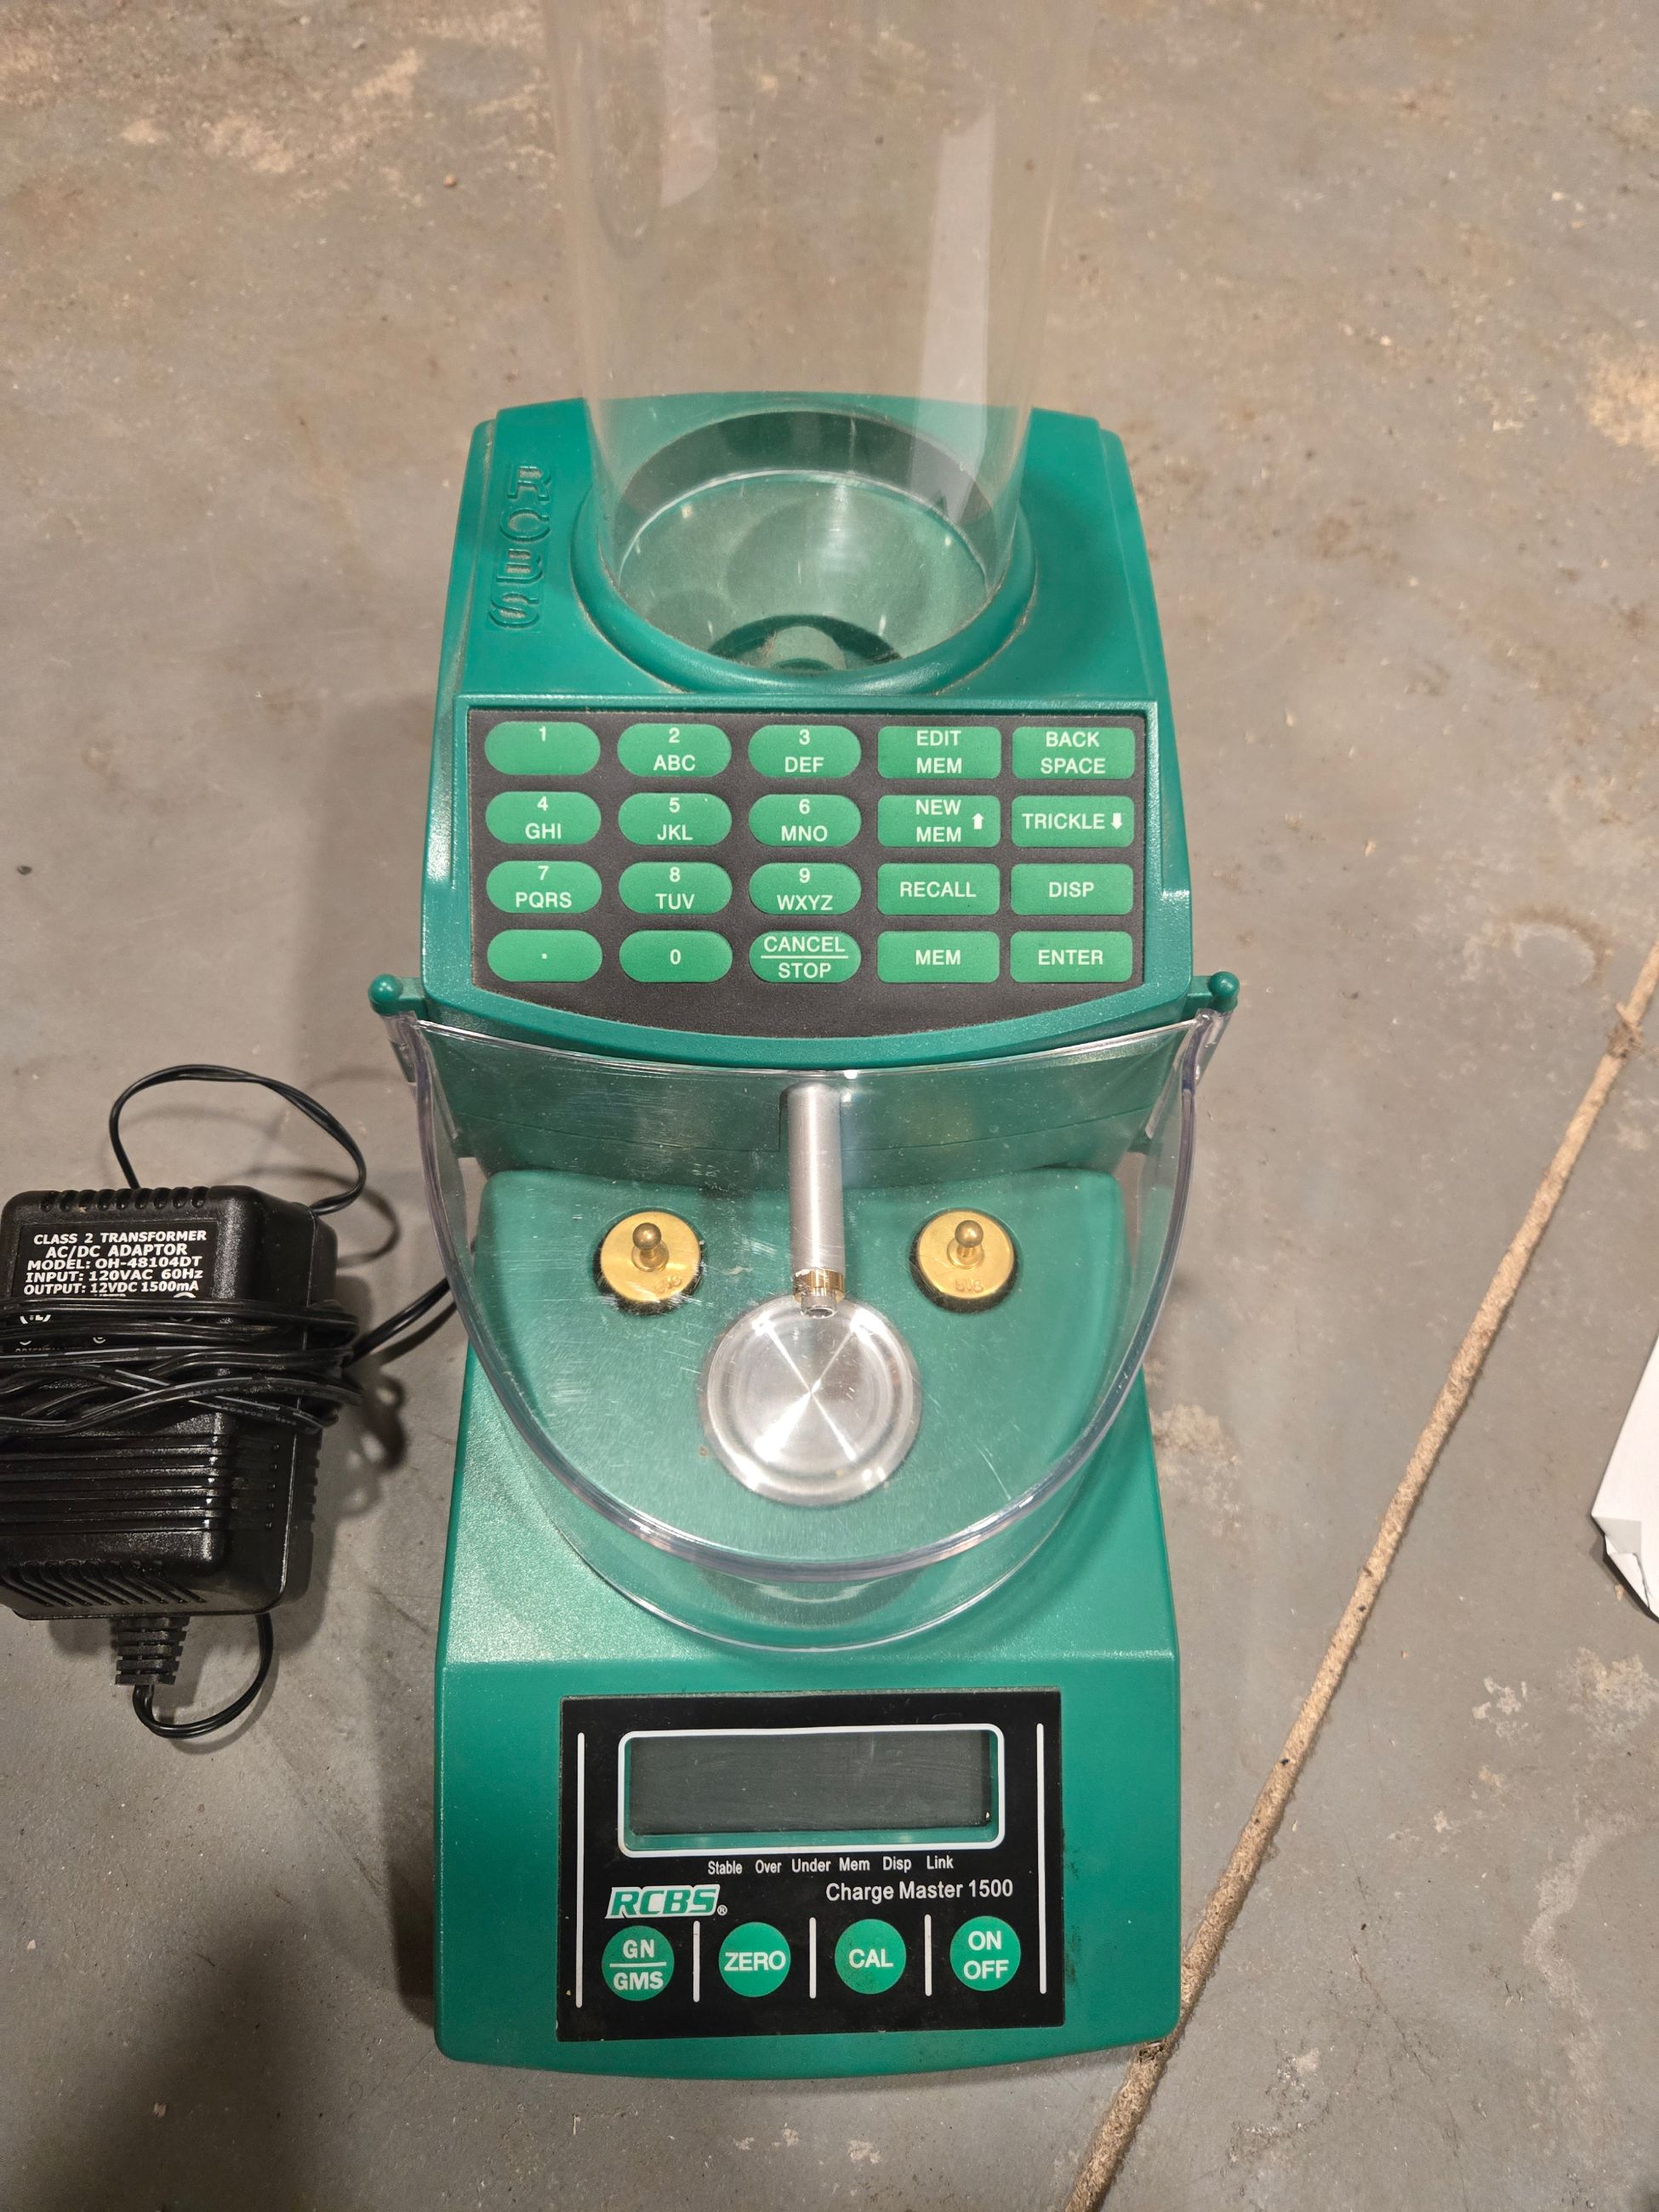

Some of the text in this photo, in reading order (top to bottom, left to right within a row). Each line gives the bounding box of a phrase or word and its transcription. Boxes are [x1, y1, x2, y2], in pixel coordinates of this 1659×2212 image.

[488, 465, 551, 629] RCBS
[539, 727, 545, 741] 1
[670, 727, 680, 743] 2
[800, 729, 810, 744] 3
[917, 730, 961, 745] EDIT
[1046, 732, 1099, 747] BACK
[653, 755, 695, 771] ABC
[785, 757, 824, 772] DEF
[917, 758, 961, 773] MEM
[1041, 758, 1105, 773] SPACE
[538, 796, 548, 811] 4
[670, 797, 680, 812] 5
[800, 799, 810, 814] 6
[916, 800, 961, 815] NEW
[1023, 813, 1104, 829] TRICKLE
[526, 823, 561, 839] GHI
[658, 824, 693, 840] JKL
[782, 825, 827, 841] MNO
[917, 827, 961, 841] MEM
[539, 865, 549, 880] 7
[670, 867, 680, 881] 8
[800, 868, 810, 883] 9
[900, 881, 976, 897] RECALL
[1049, 881, 1094, 897] DISP
[516, 892, 572, 908] PQRS
[655, 893, 694, 909] TUV
[778, 895, 833, 910] WXYZ
[764, 936, 845, 952] CANCEL
[670, 949, 681, 964] 0
[916, 949, 961, 965] MEM
[1039, 949, 1103, 965] ENTER
[778, 962, 830, 978] STOP
[34, 1230, 206, 1245] CLASS 2 TRANSFORMER
[46, 1243, 187, 1258] AC/DC ADAPTOR
[28, 1256, 202, 1270] MODEL: OH-48104DT
[26, 1268, 202, 1282] INPUT: 120VAC 60Hz
[24, 1283, 86, 1295] OUTPUT:
[91, 1282, 137, 1292] 12VDC
[141, 1280, 198, 1291] 1500mA
[708, 1856, 953, 1874] Stable Over Under Mem Disp Link
[826, 1879, 1012, 1904] Charge Master 1500
[968, 1930, 1001, 1950] ON
[624, 1940, 654, 1958] GN
[725, 1951, 786, 1970] ZERO
[849, 1949, 893, 1968] CAL
[964, 1960, 1008, 1980] OFF
[613, 1971, 663, 1990] GMS
